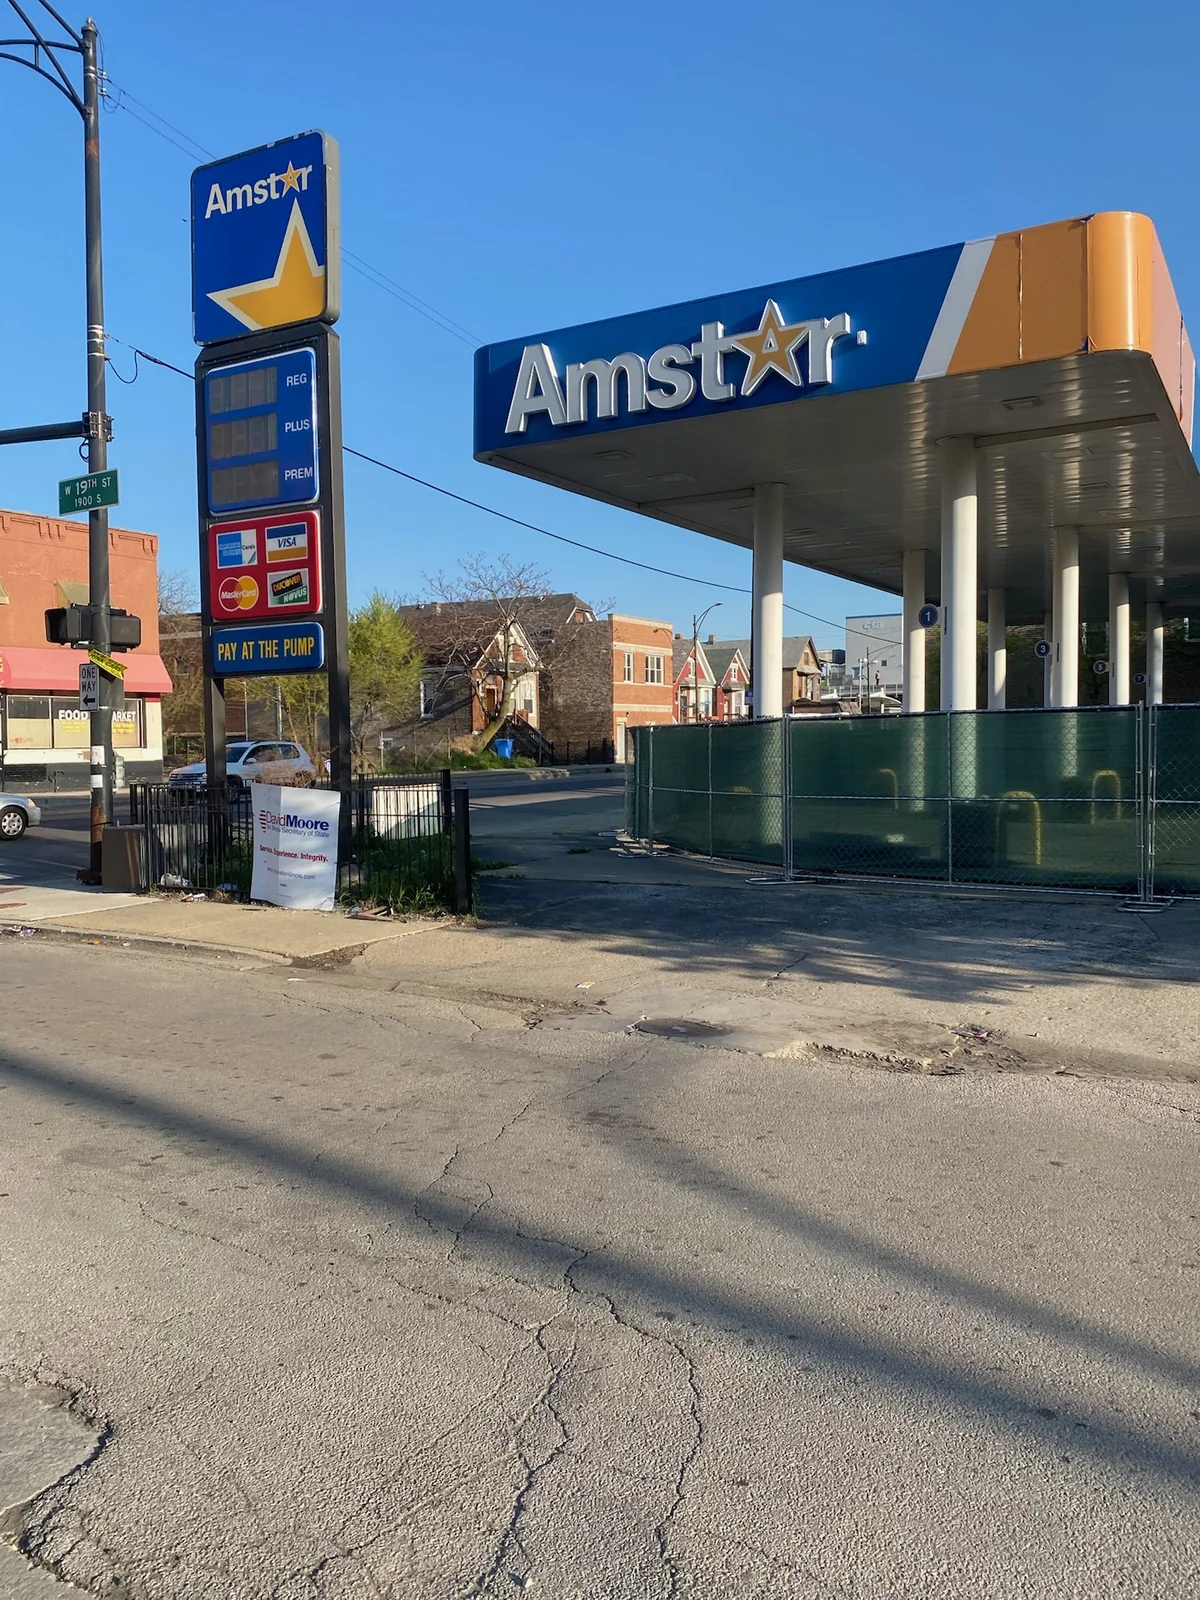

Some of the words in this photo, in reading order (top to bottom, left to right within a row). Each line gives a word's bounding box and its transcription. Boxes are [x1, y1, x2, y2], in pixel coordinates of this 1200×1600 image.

[286, 373, 308, 387] REG
[284, 418, 310, 433] PLUS
[284, 466, 313, 481] PREM
[64, 485, 72, 496] W
[75, 477, 97, 496] 19TH
[101, 476, 112, 488] ST
[74, 495, 93, 508] 1900
[96, 493, 102, 504] S
[277, 536, 297, 549] VISA
[220, 588, 257, 600] MasterCard
[283, 586, 308, 604] NOVUS
[925, 610, 931, 622] 1
[217, 642, 237, 662] PAY
[241, 640, 255, 661] AT
[258, 638, 279, 659] THE
[283, 636, 315, 658] PUMP
[1040, 644, 1046, 653] 3
[81, 667, 96, 679] ONE
[81, 681, 96, 693] WAY
[58, 709, 89, 721] FOOD
[111, 710, 137, 722] ARKET
[281, 827, 306, 837] Secretary
[314, 830, 330, 839] State
[300, 852, 329, 863] Integrity.
